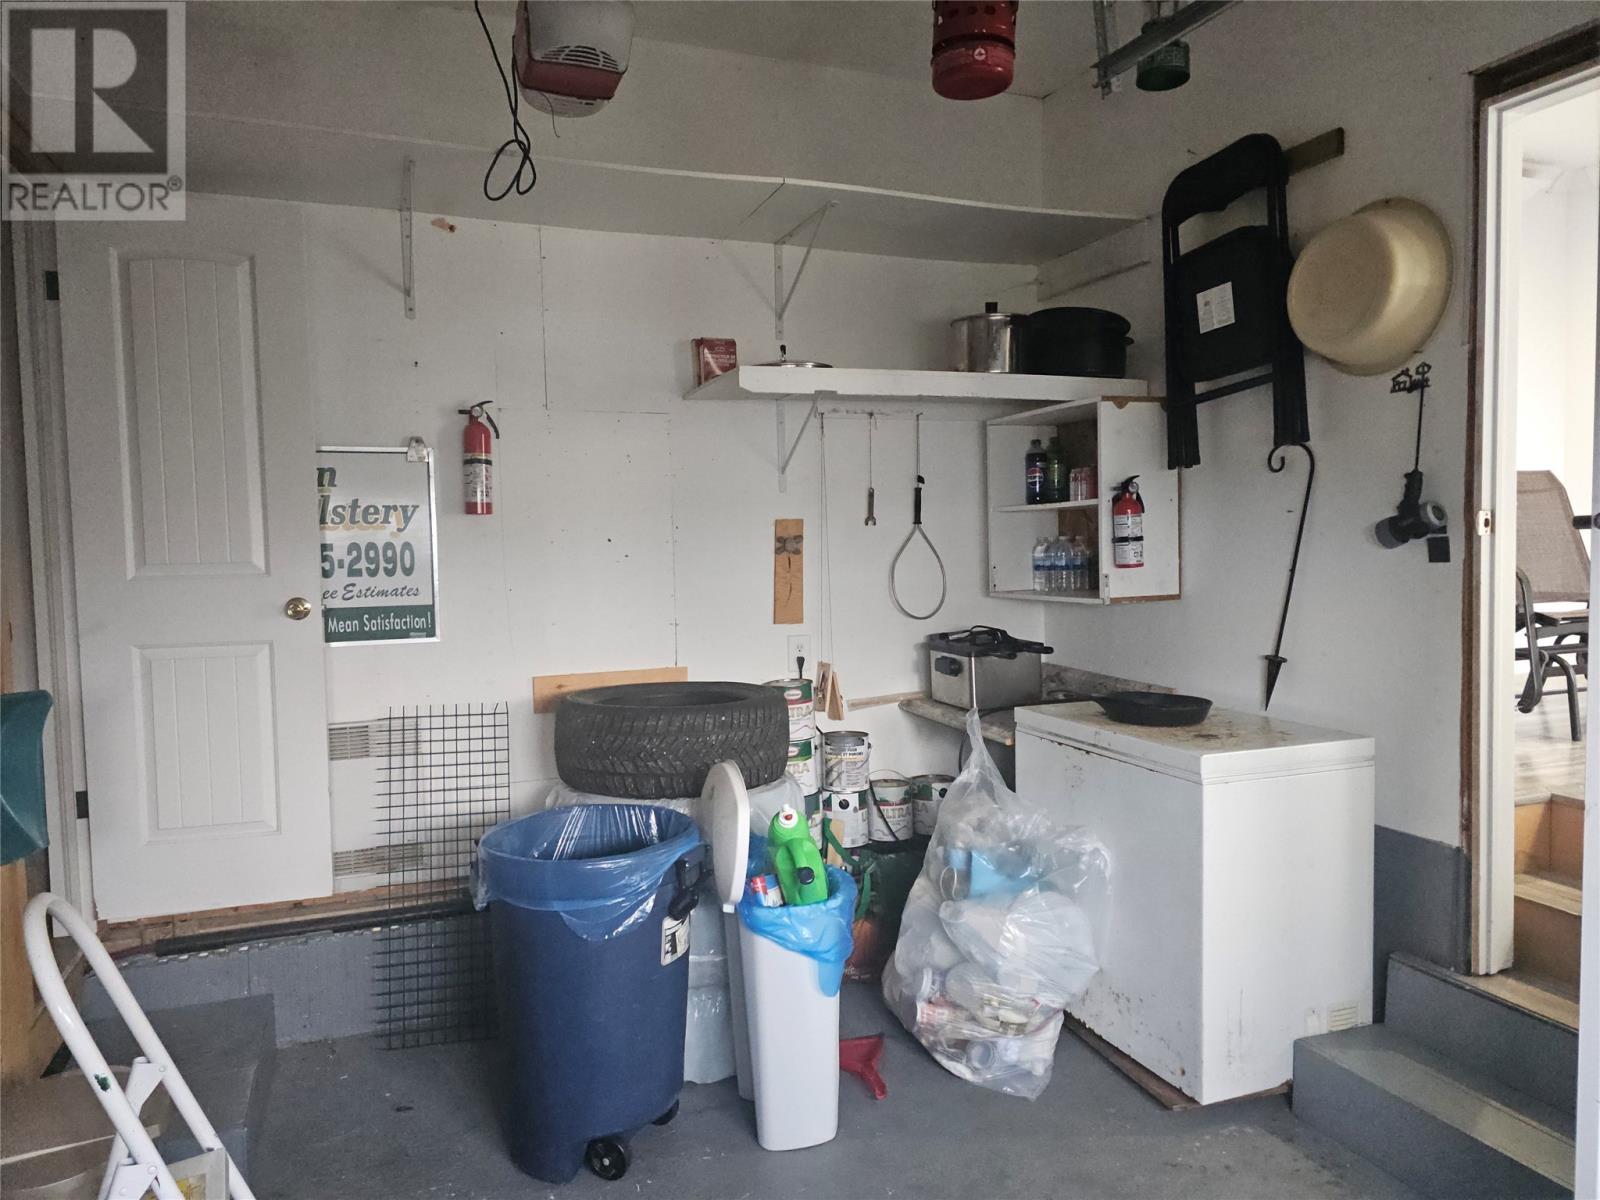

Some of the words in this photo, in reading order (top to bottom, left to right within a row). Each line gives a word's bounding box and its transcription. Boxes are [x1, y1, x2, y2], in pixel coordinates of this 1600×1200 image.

[342, 582, 420, 601] Estimates
[328, 617, 359, 633] Mean
[363, 611, 432, 632] Satisfaction!
